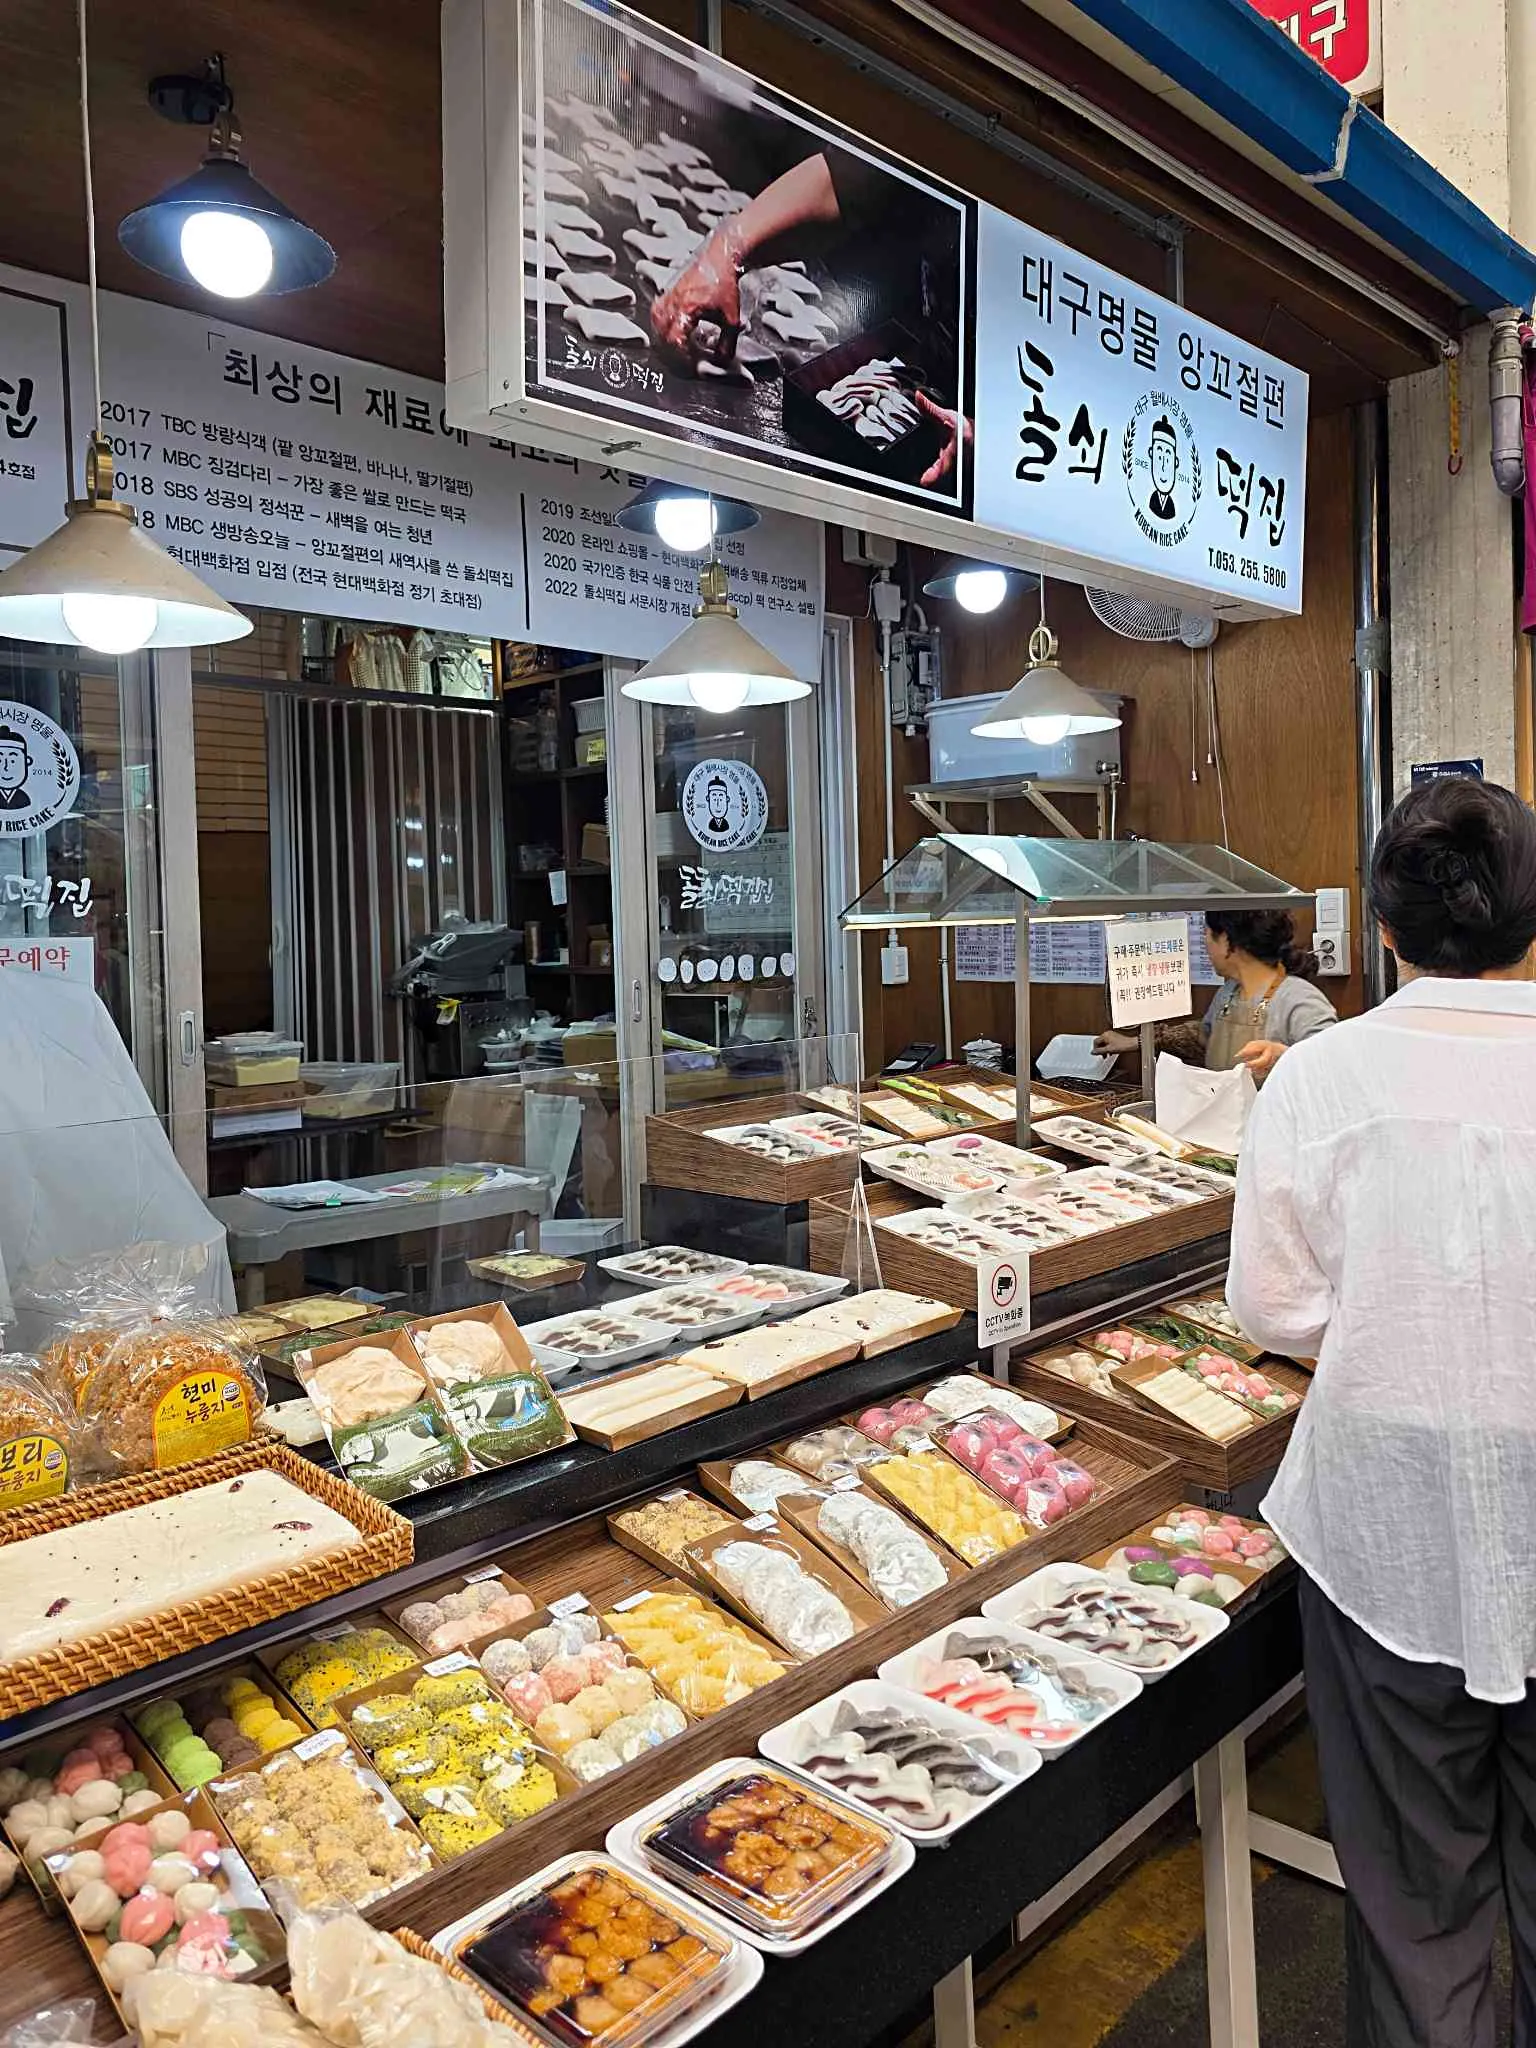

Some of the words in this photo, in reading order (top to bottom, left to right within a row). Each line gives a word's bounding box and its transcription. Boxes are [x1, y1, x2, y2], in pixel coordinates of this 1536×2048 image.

[1022, 255, 1160, 372] 대구명물
[1177, 332, 1286, 430] 앙꼬절편
[223, 348, 342, 415] 최상의
[100, 400, 151, 427] 2017
[161, 414, 197, 436] TBC
[202, 422, 267, 453] 방랑식객
[298, 444, 361, 473] 앙꼬절편,
[366, 459, 412, 484] 바나나,
[417, 470, 473, 498] 딸기절편)
[1015, 340, 1108, 485] 돌쇠
[1215, 447, 1286, 547] 떡집
[112, 472, 154, 495] 018
[164, 481, 198, 501] SBS
[204, 487, 253, 512] 성공의
[259, 497, 305, 522] 정석꾼
[325, 511, 368, 534] 새벽을
[374, 519, 402, 539] 여는
[406, 525, 433, 546] 청년
[163, 448, 201, 470] MBC
[208, 456, 271, 485] 징검다리
[293, 474, 324, 494] 가장
[328, 481, 358, 502] 좋은
[362, 487, 391, 508] 쌀로
[395, 495, 437, 518] 만드는
[440, 505, 467, 524] 떡국
[165, 514, 204, 534] MBC
[210, 520, 290, 550] 생방송오늘
[311, 538, 384, 566] 앙꼬절편의
[389, 551, 441, 575] 새역사를
[445, 563, 459, 579] 쓴
[463, 565, 514, 588] 돌쇠떡집
[541, 499, 574, 519] 2019
[726, 538, 745, 556] 선정
[542, 526, 575, 546] 2020
[581, 533, 614, 553] 온라인
[617, 541, 648, 561] 쇼핑몰
[1134, 508, 1157, 544] KOREAN
[1159, 532, 1173, 547] RICE
[1173, 523, 1189, 545] CAKE
[166, 544, 250, 575] 현대백화점
[257, 560, 287, 580] 입점
[292, 565, 328, 586] (전국
[332, 571, 405, 597] 현대백화점
[409, 584, 435, 603] 정기
[440, 590, 482, 610] 초대점)
[543, 552, 577, 572] 2020
[582, 560, 625, 581] 국가인증
[629, 567, 649, 585] 한국
[652, 573, 671, 590] 식품
[674, 578, 693, 593] 안전
[727, 591, 753, 606] accp)
[756, 594, 765, 608] 떡
[767, 596, 794, 613] 연구소
[798, 600, 816, 616] 설립
[545, 578, 578, 598] 2022
[583, 584, 626, 605] 돌쇠떡집
[629, 593, 668, 614] 서문시장
[670, 600, 691, 617] 개점
[31, 718, 55, 740] 명물
[6, 819, 28, 832] RICE
[29, 807, 55, 828] CAKE
[181, 1377, 216, 1403] 현미
[185, 1399, 225, 1424] 누룽지
[0, 1439, 43, 1473] 보리
